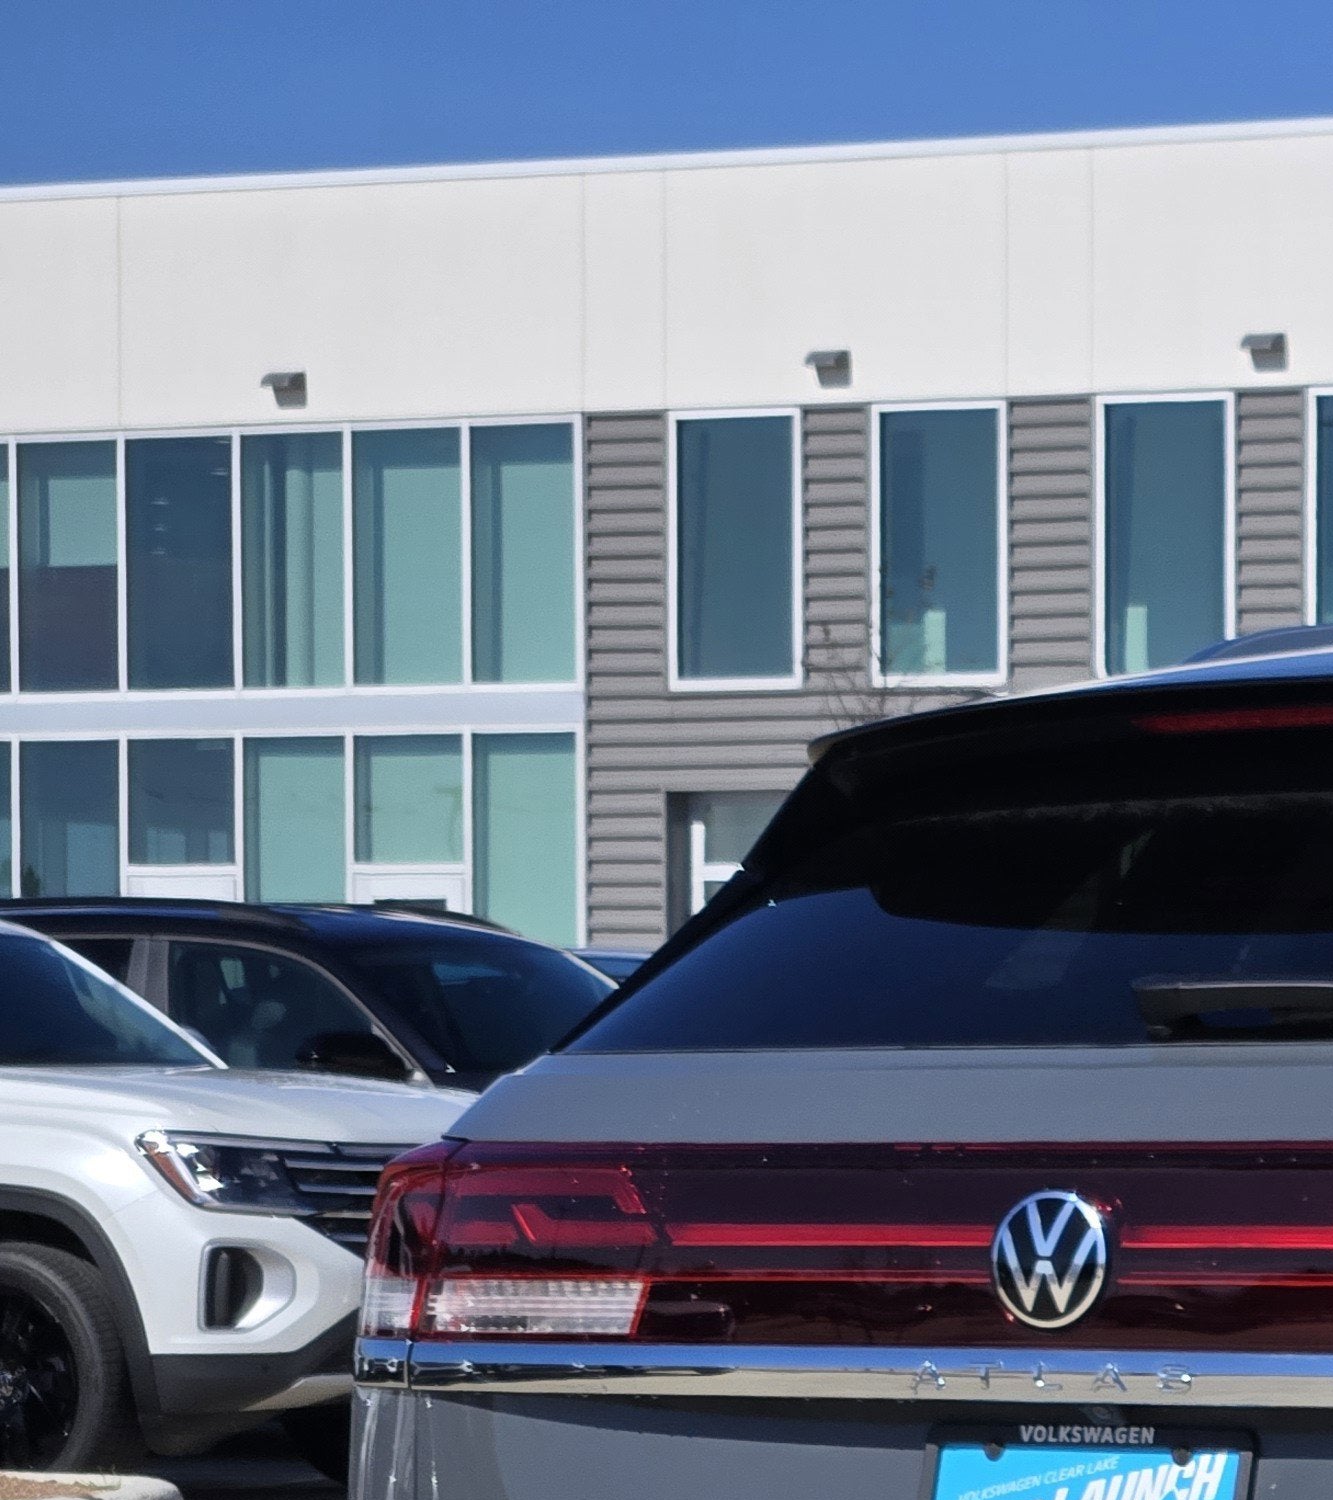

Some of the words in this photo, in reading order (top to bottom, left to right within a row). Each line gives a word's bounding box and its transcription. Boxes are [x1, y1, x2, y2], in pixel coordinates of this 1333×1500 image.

[911, 1360, 1194, 1394] ATLAS
[1019, 1424, 1156, 1445] VOLKSWAGEN
[1043, 1464, 1086, 1485] CLEAR
[1086, 1455, 1121, 1476] LAKE
